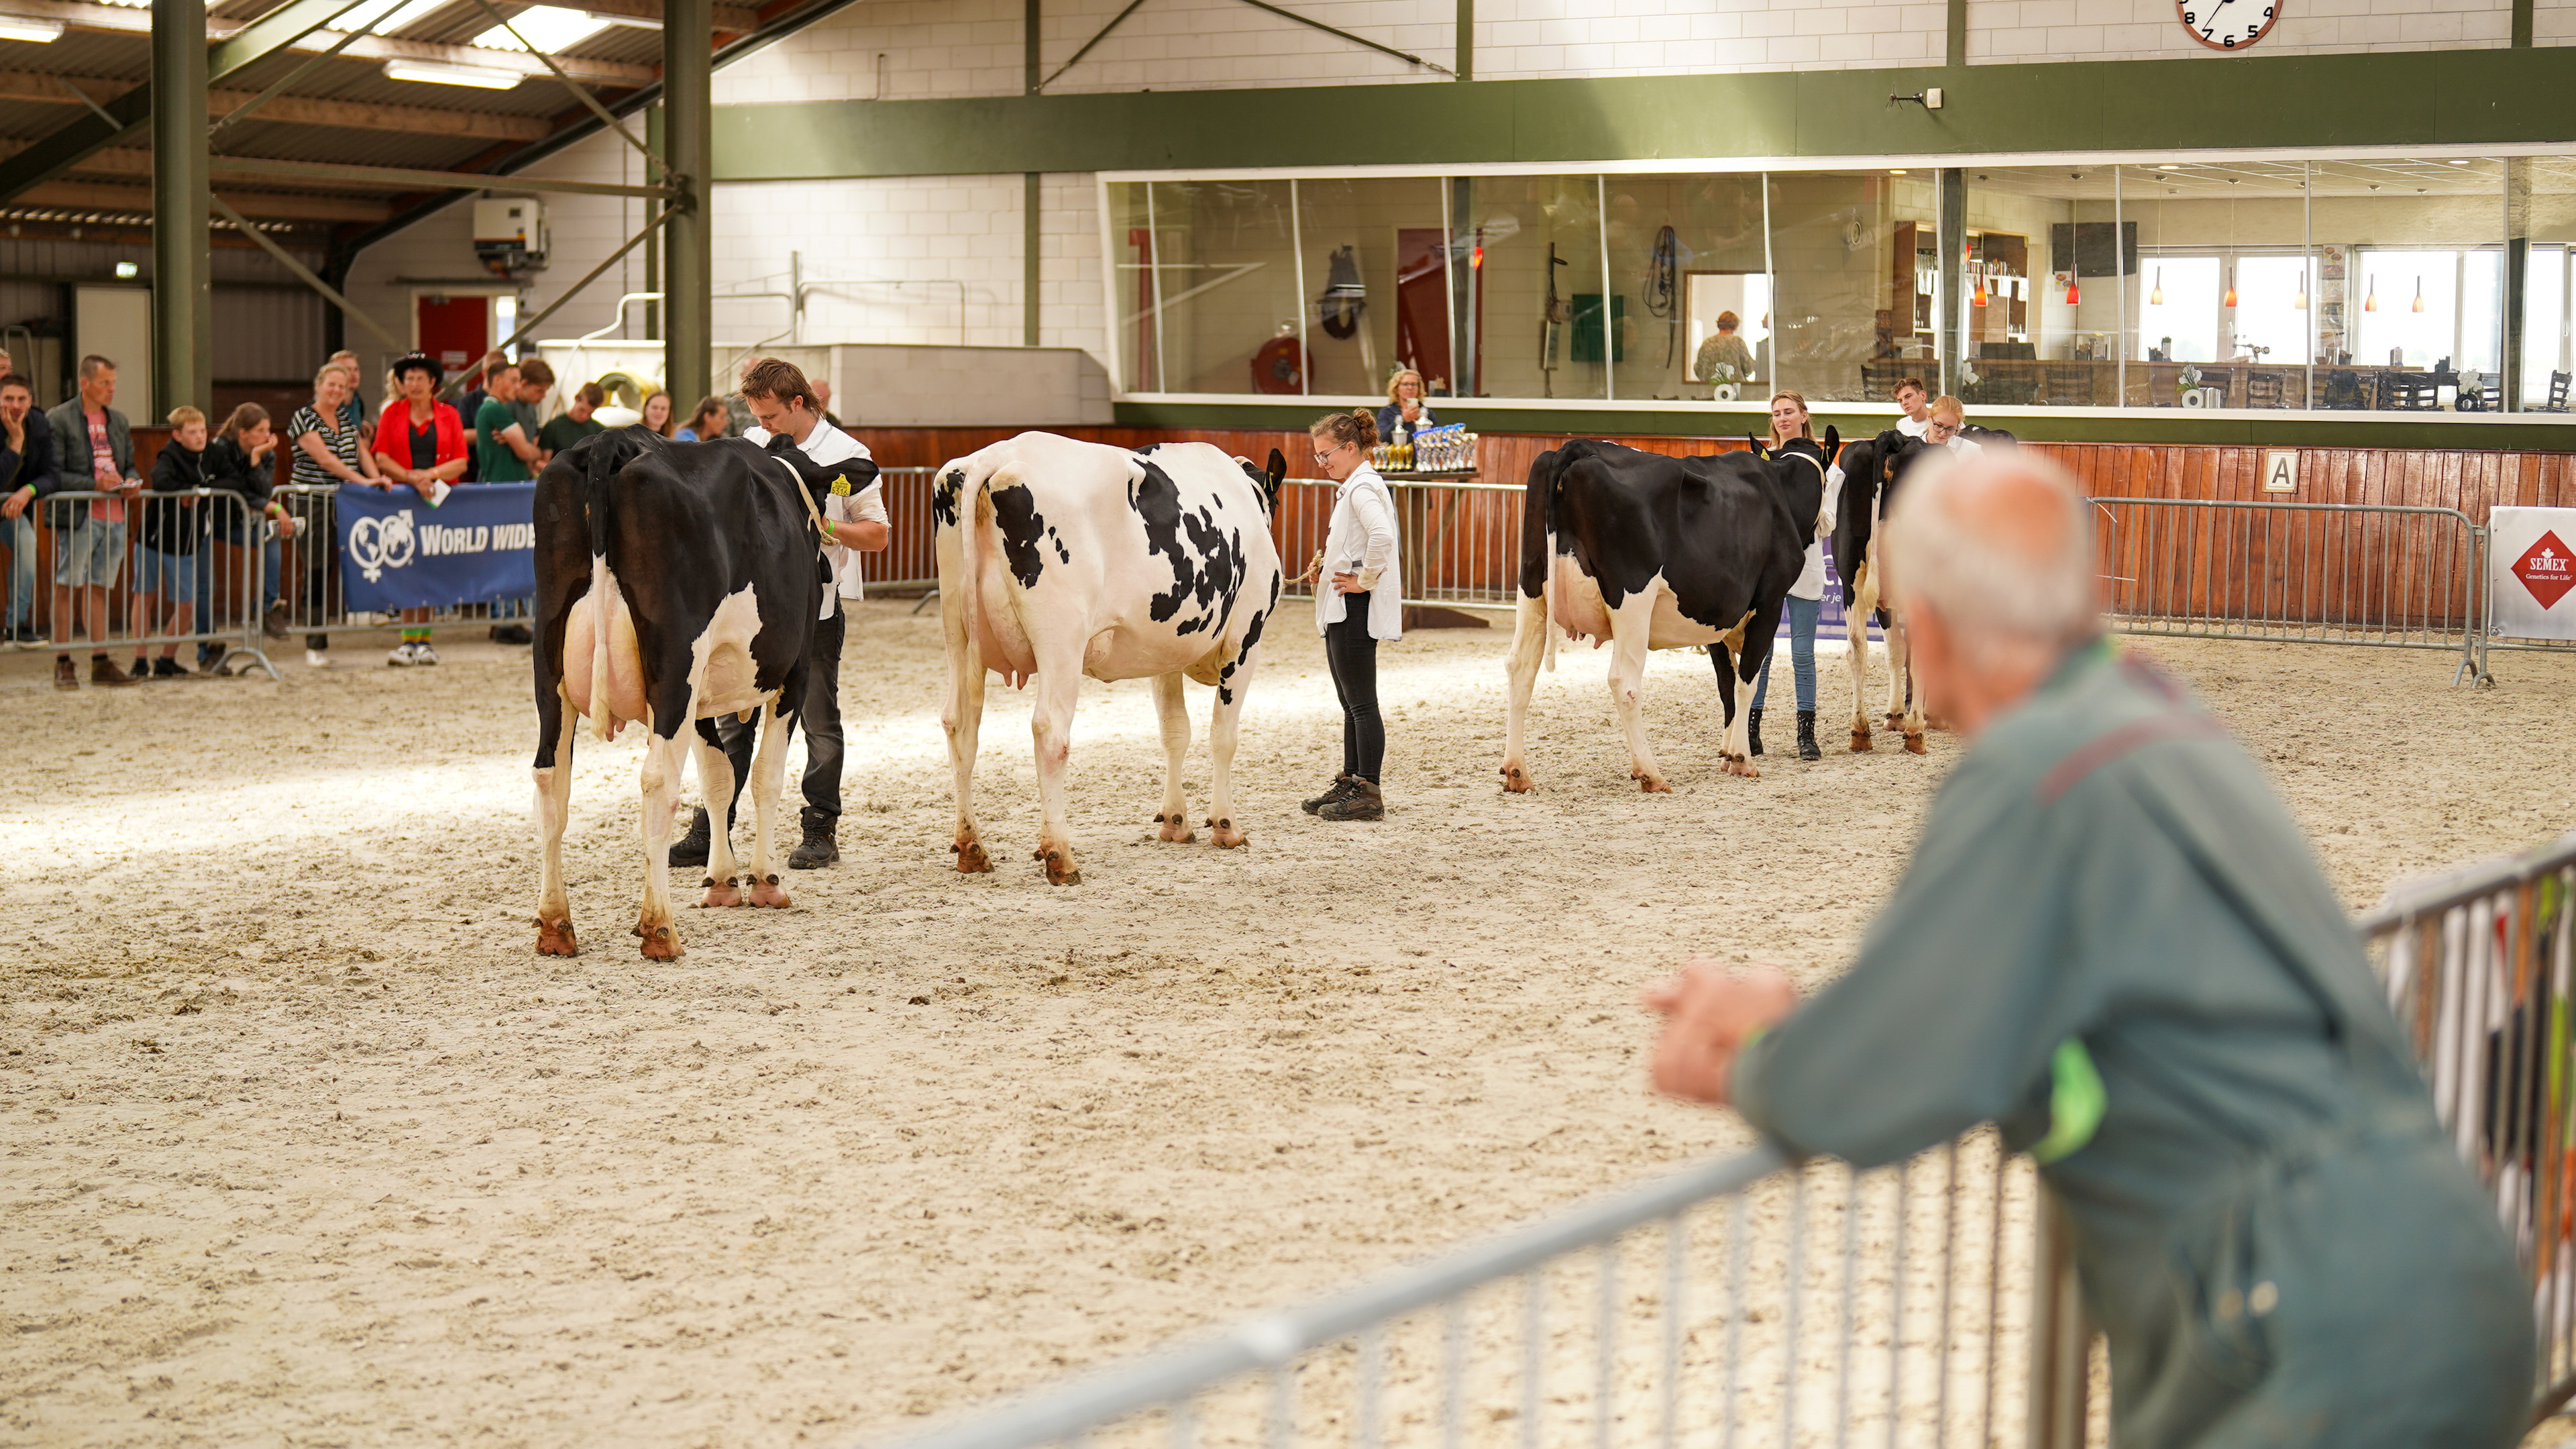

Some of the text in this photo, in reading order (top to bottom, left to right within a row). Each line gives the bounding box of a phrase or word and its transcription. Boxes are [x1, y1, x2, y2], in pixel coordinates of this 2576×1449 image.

[2184, 11, 2195, 24] 8
[2263, 7, 2273, 19] 4
[2202, 28, 2214, 41] 7
[2247, 25, 2258, 38] 5
[2224, 35, 2235, 48] 6
[2271, 457, 2290, 484] A
[419, 524, 489, 556] WORLD
[2530, 557, 2567, 572] SEMEX
